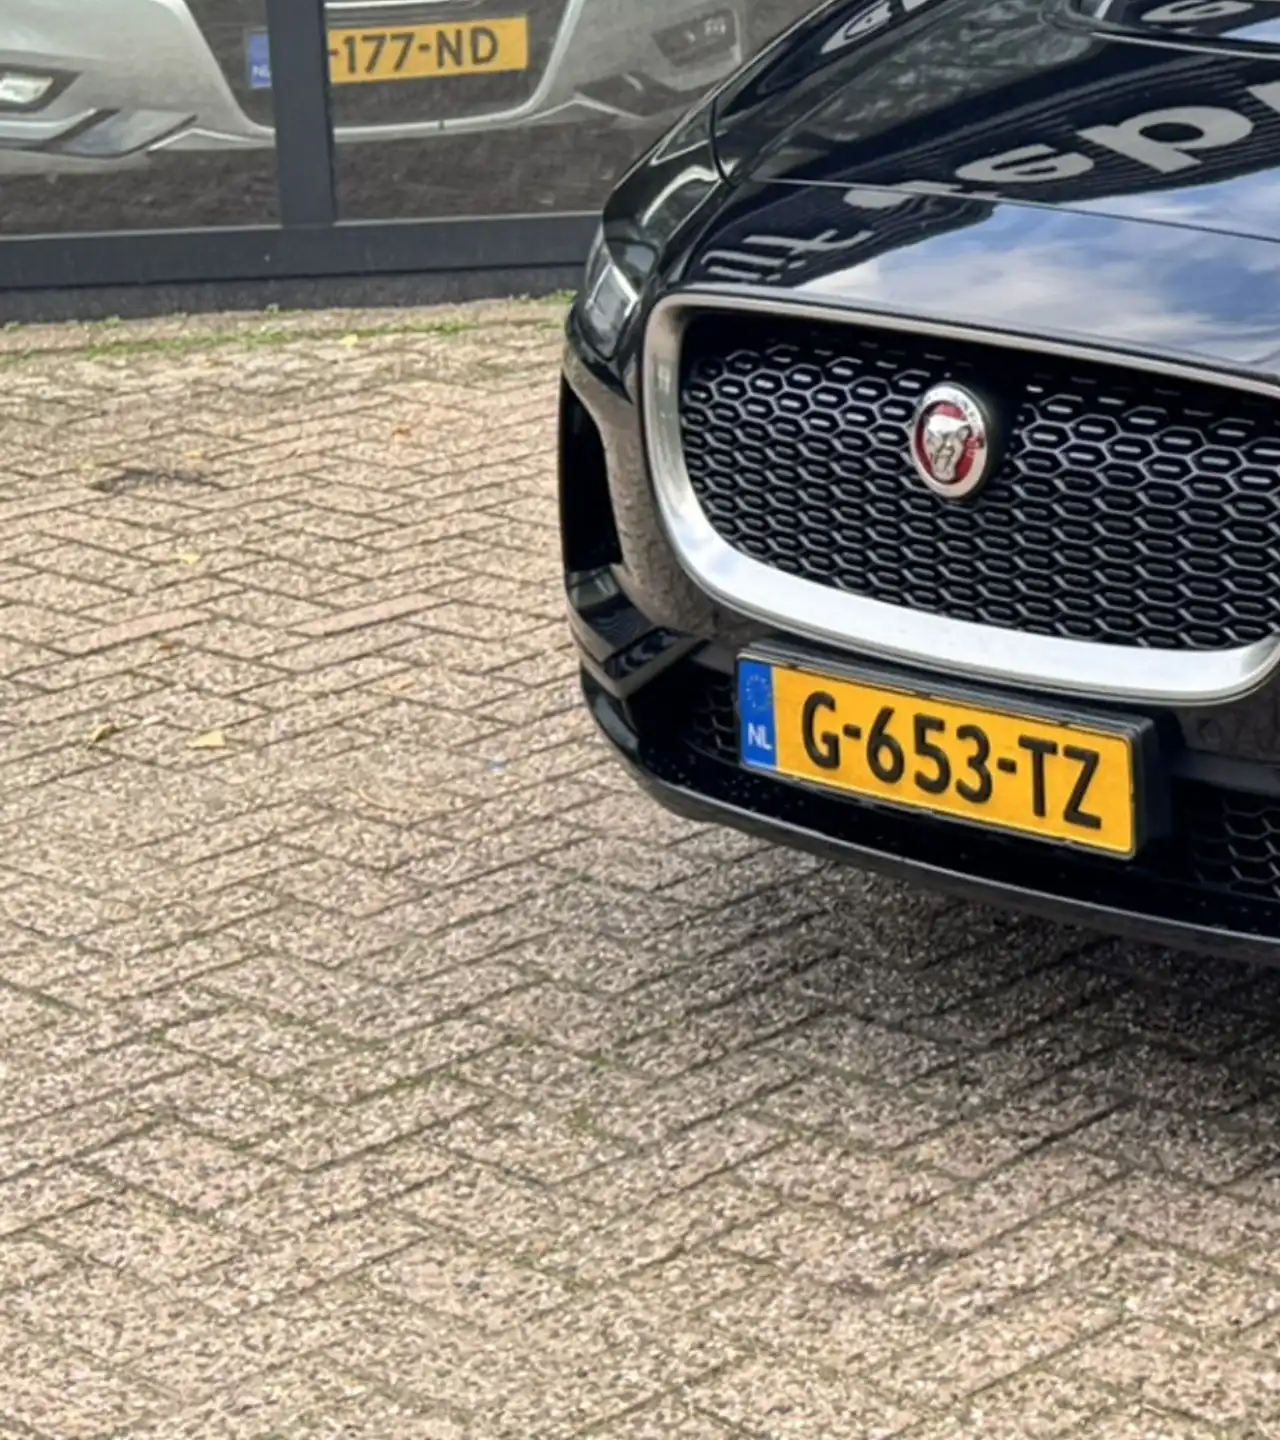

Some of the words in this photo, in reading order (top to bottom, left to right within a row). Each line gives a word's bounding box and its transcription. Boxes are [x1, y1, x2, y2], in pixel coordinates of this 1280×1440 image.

[330, 27, 497, 74] -177-ND
[747, 722, 772, 750] NL
[801, 691, 1102, 830] G-653-TZ
